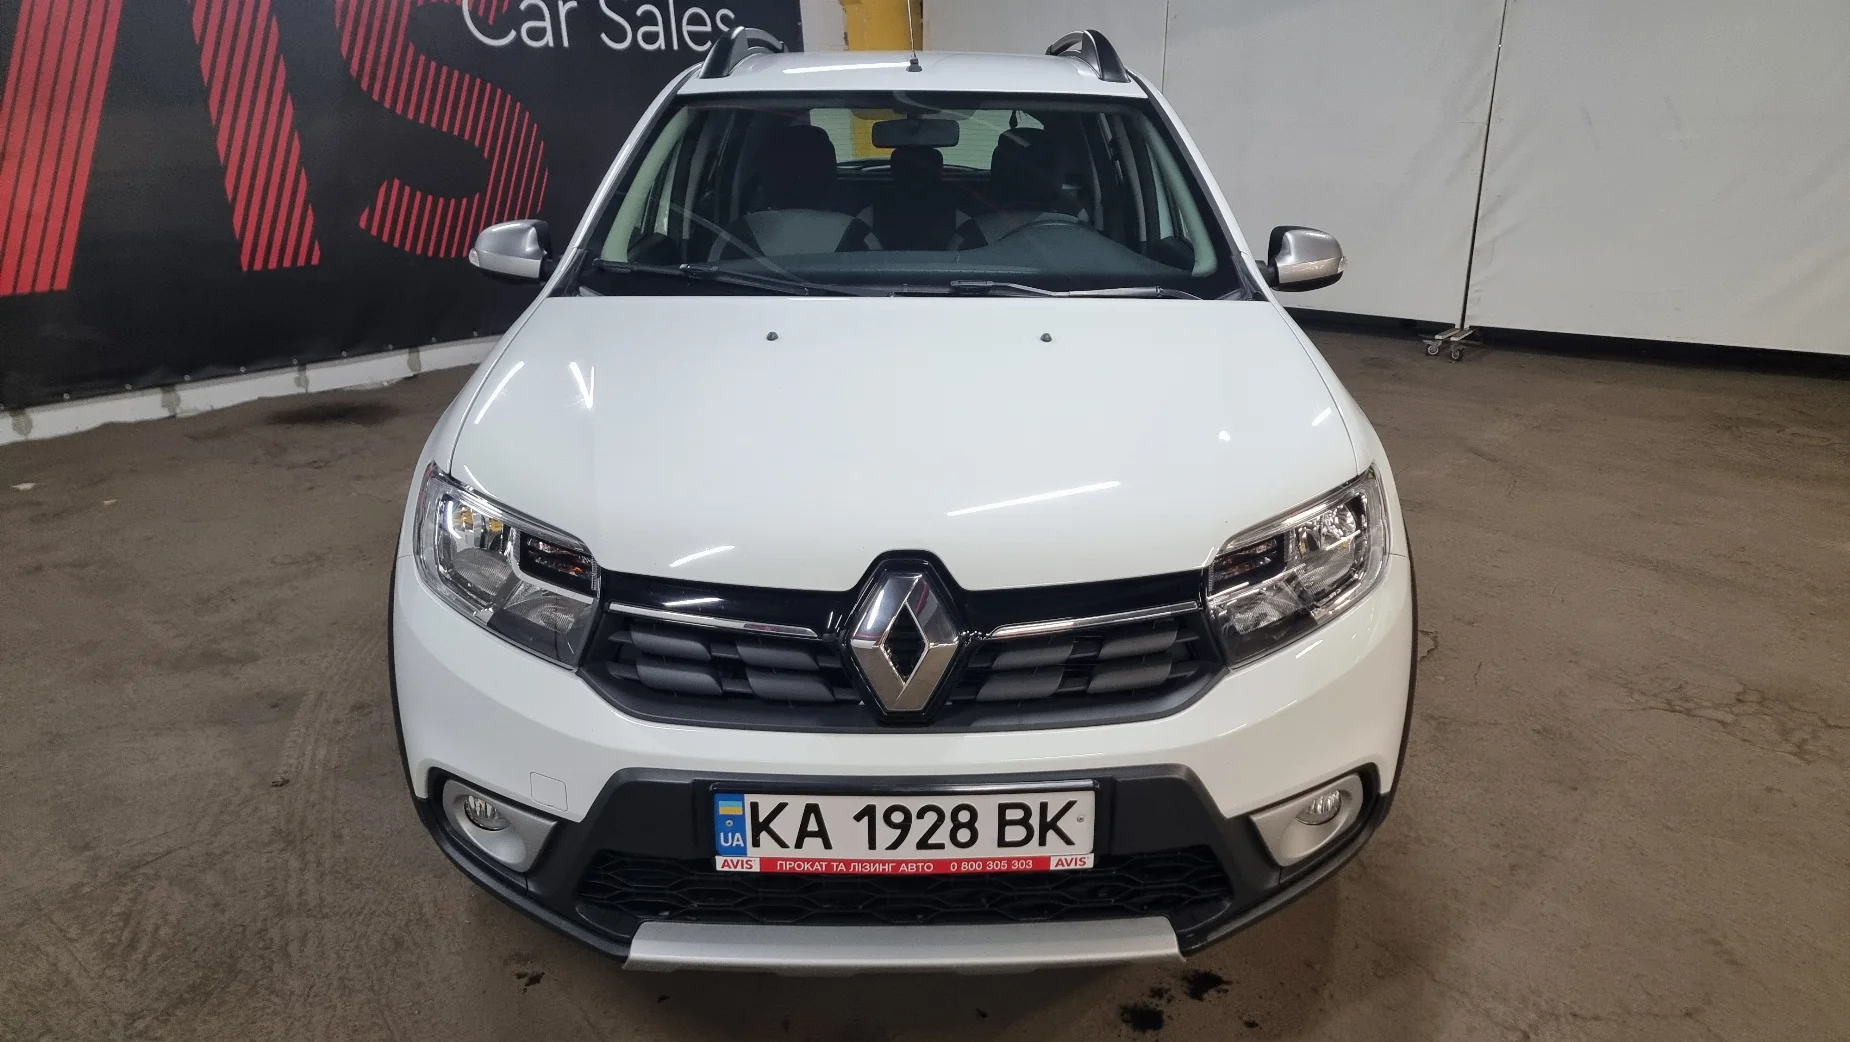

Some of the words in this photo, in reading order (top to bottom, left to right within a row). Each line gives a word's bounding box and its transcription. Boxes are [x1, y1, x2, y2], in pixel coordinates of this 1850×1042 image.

[462, 0, 578, 47] Car
[750, 801, 833, 850] KA
[852, 803, 979, 850] 1928
[997, 800, 1078, 848] BK
[720, 832, 744, 847] UA
[721, 859, 754, 870] AVIS
[777, 860, 828, 872] ПРОКАТ
[831, 861, 846, 872] ТА
[849, 862, 897, 873] ЛІЗИНГ
[898, 862, 934, 872] АВТО
[950, 862, 958, 872] 0
[961, 862, 983, 871] 800
[986, 860, 1008, 870] 305
[1011, 859, 1033, 869] 303
[1054, 856, 1087, 868] AVIS
